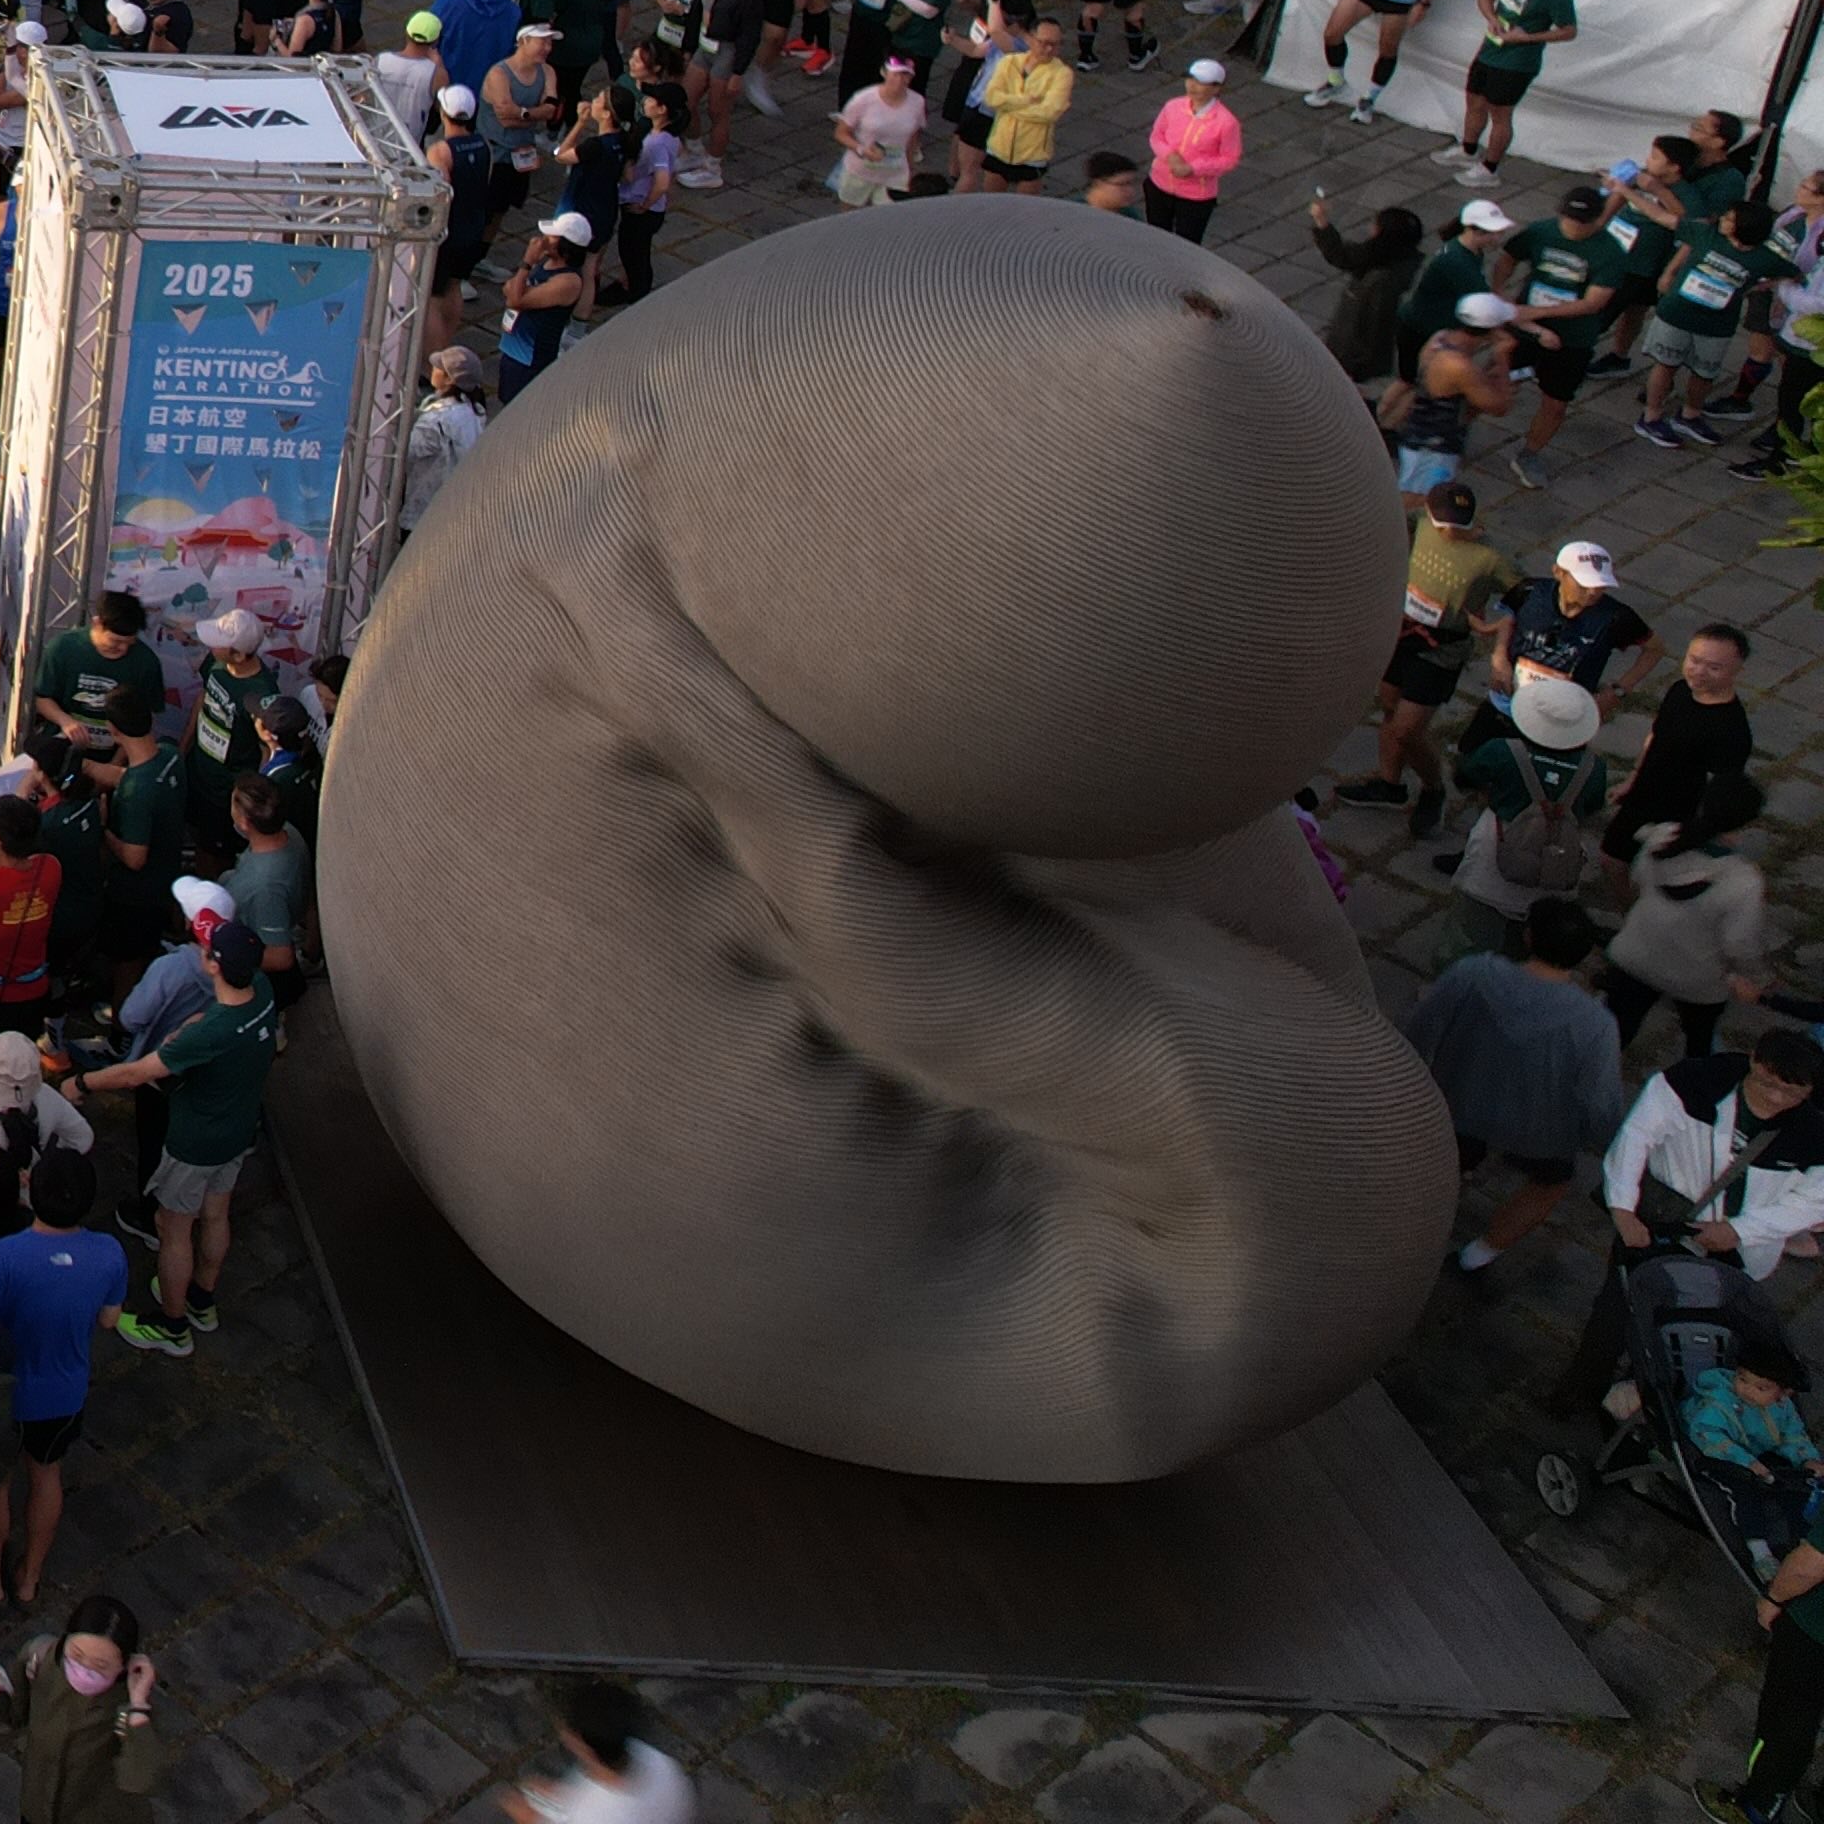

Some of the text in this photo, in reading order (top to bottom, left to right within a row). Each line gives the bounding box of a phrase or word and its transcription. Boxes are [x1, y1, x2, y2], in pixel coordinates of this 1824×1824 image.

[159, 105, 310, 129] LAVA
[163, 264, 254, 297] 2025
[175, 346, 279, 357] JAPAN AIRLINES
[154, 358, 282, 381] KENTING
[153, 380, 313, 398] MARATHON
[148, 405, 247, 428] 日本航空
[144, 433, 321, 460] 墾丁國際馬拉松
